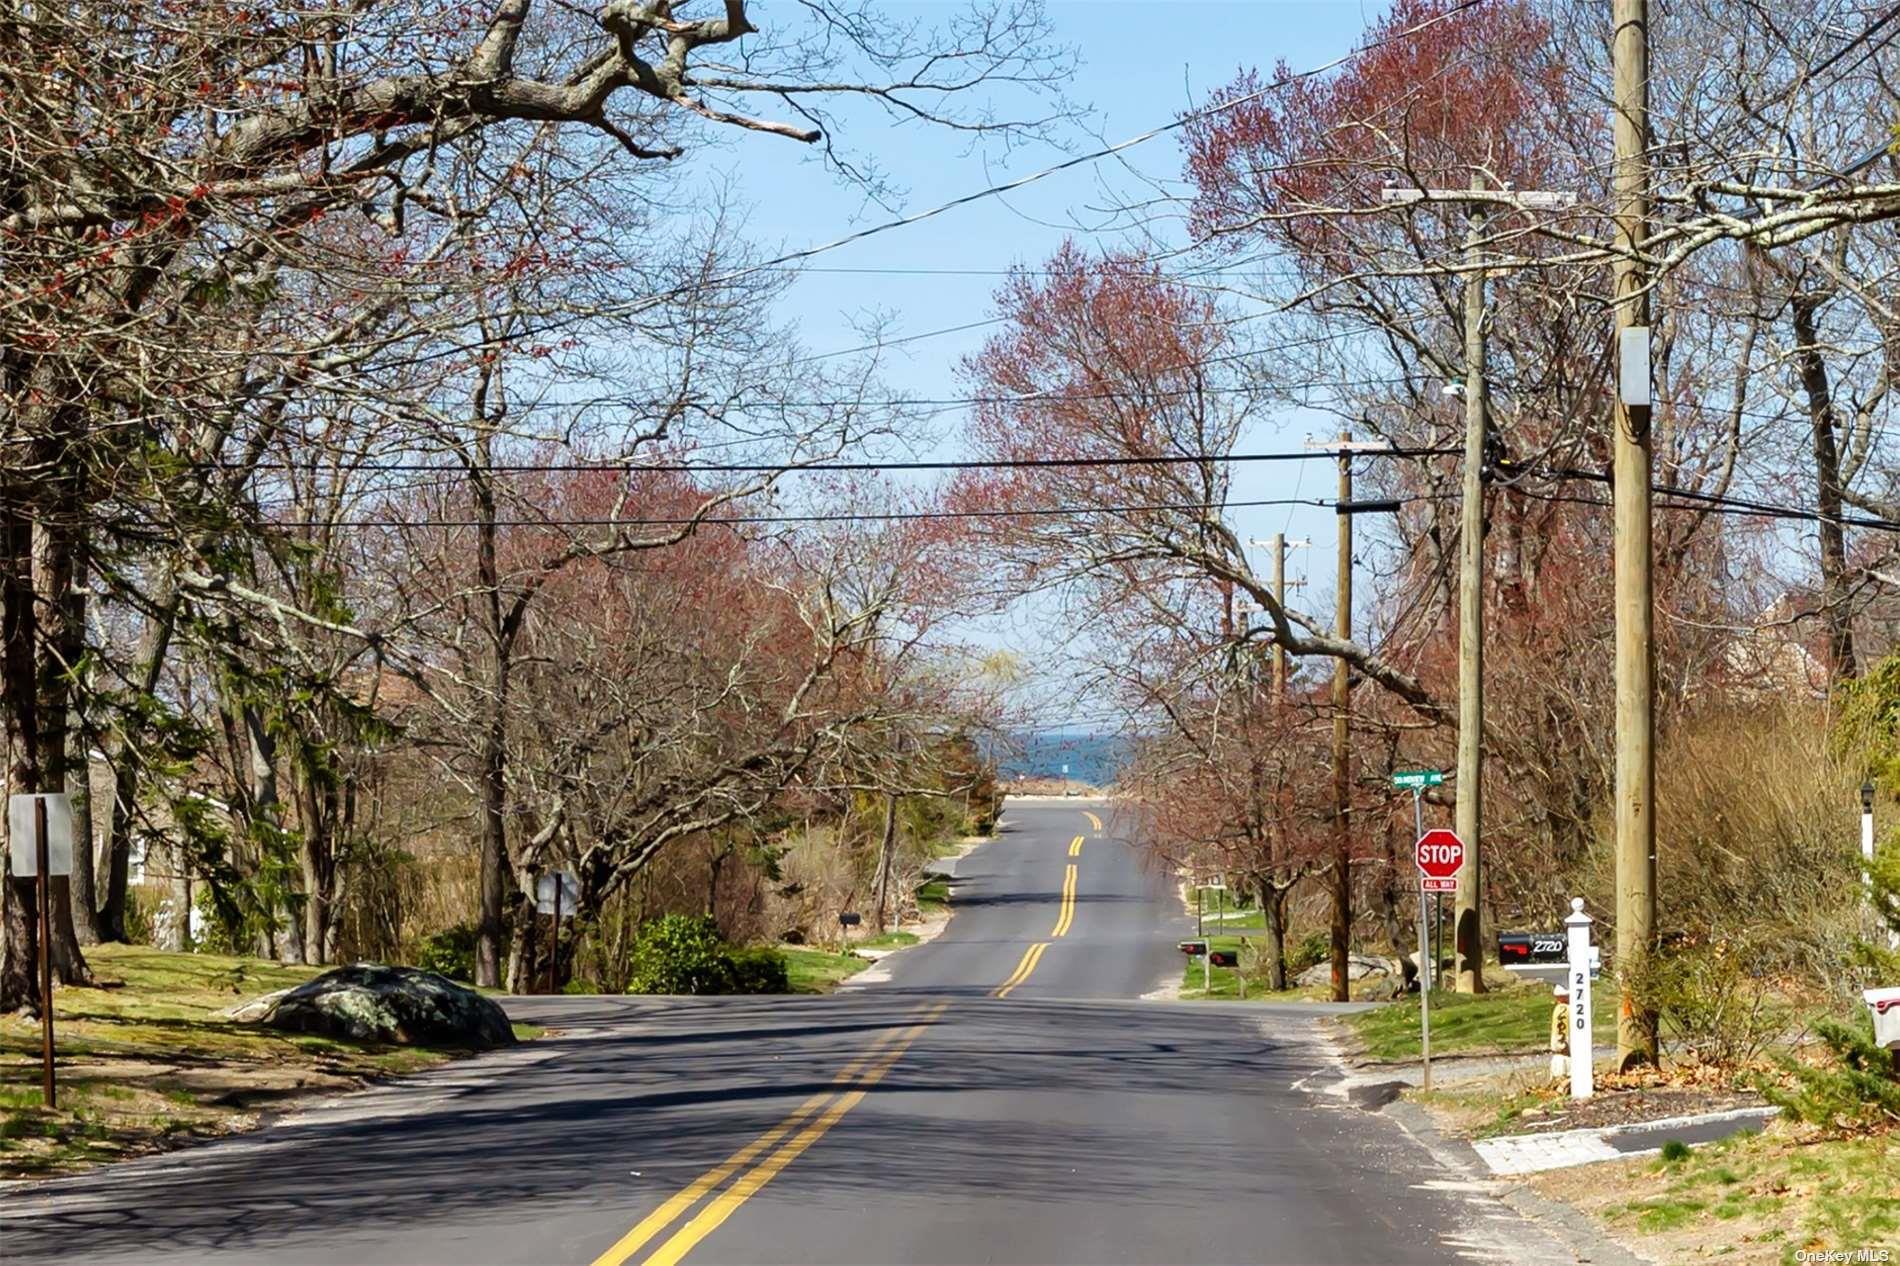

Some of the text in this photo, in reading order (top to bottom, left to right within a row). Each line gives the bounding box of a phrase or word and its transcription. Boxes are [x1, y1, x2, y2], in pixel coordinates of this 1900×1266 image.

[1420, 844, 1461, 864] STOP
[1425, 880, 1455, 888] ALL WAY
[1533, 940, 1563, 952] 2720
[1575, 972, 1585, 1030] 2720
